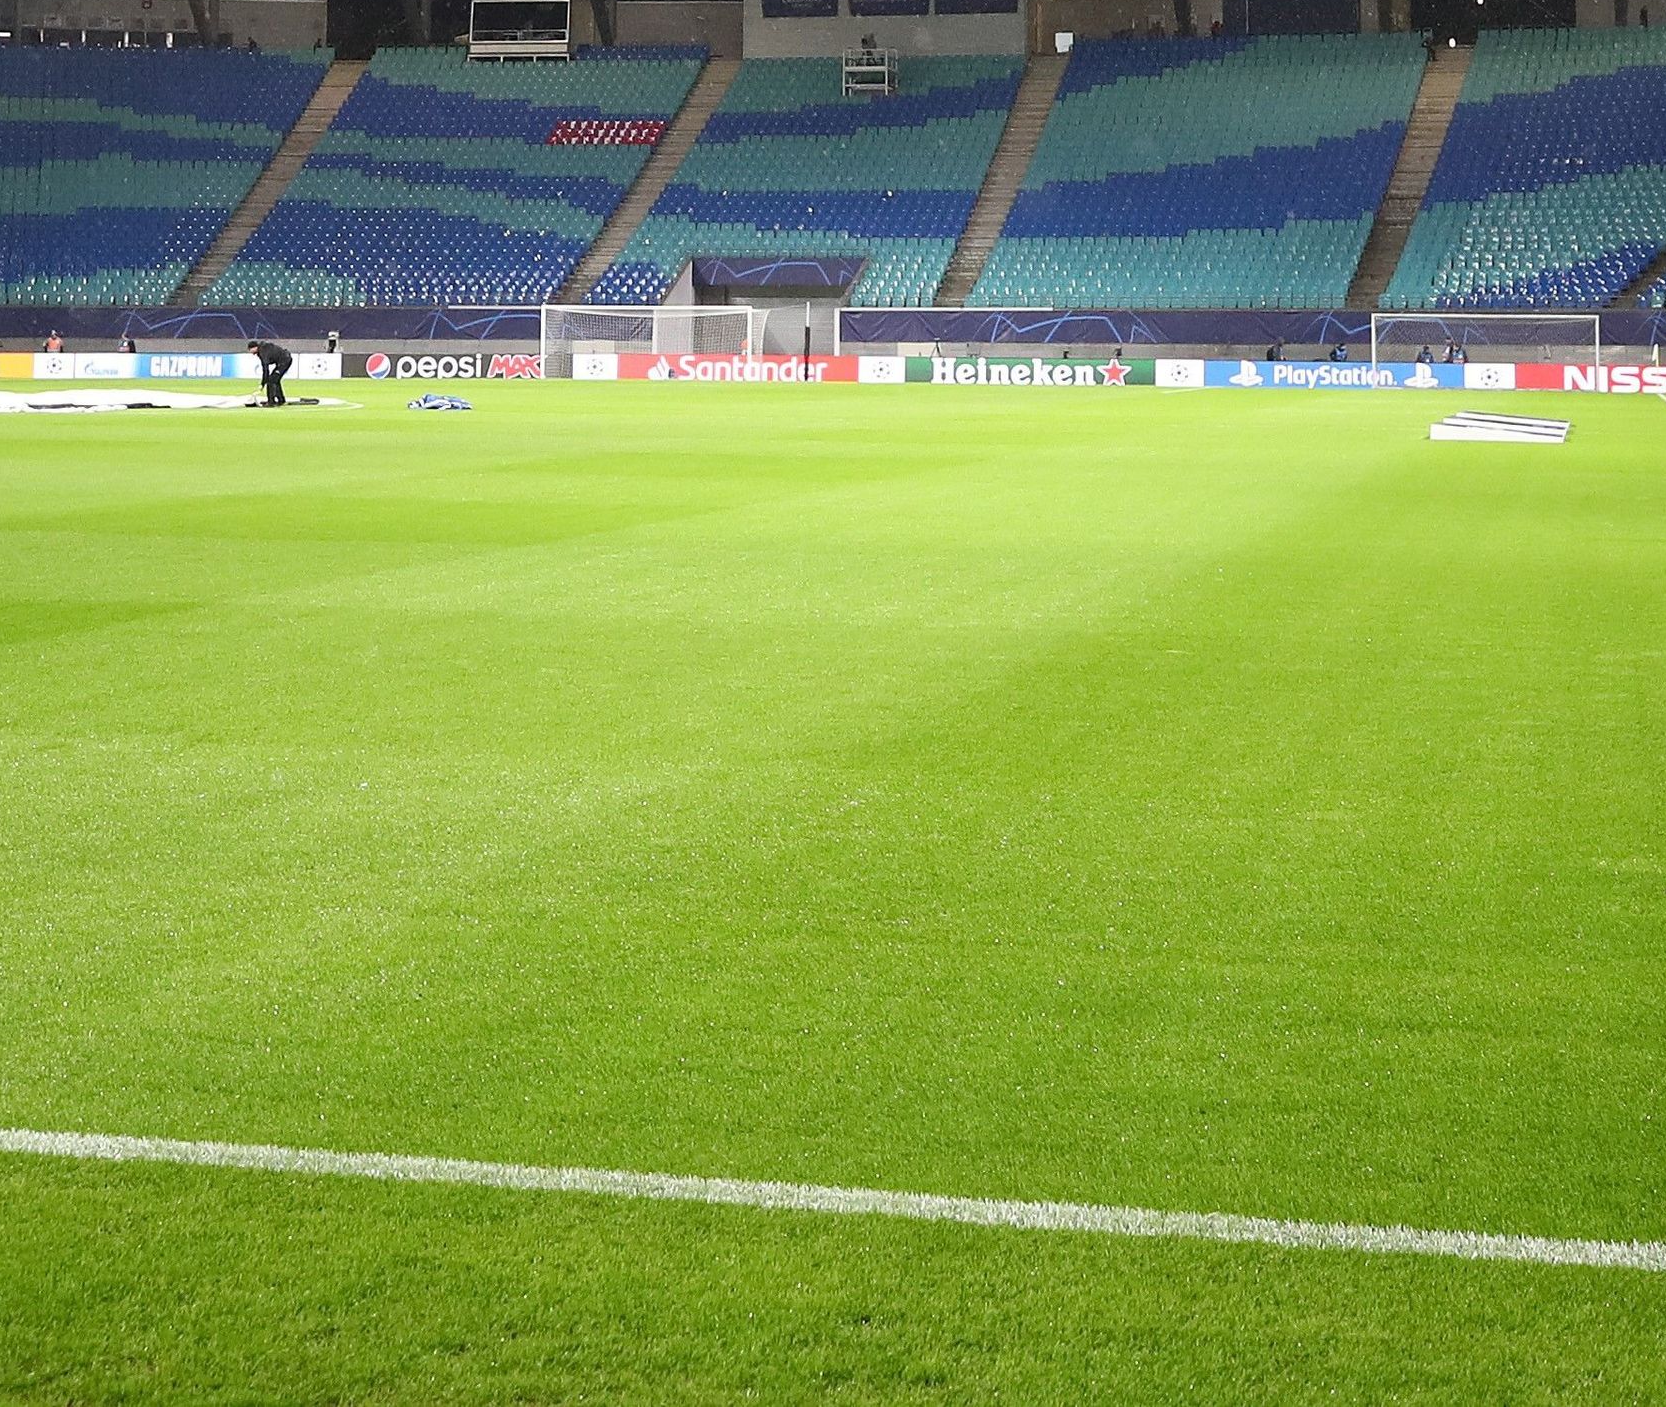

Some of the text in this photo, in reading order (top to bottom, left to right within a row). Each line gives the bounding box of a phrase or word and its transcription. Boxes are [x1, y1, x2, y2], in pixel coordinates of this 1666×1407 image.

[150, 356, 222, 377] GAZPROM
[396, 353, 541, 379] pepsi MAX
[677, 355, 828, 382] Santander
[931, 358, 1096, 385] Heineken
